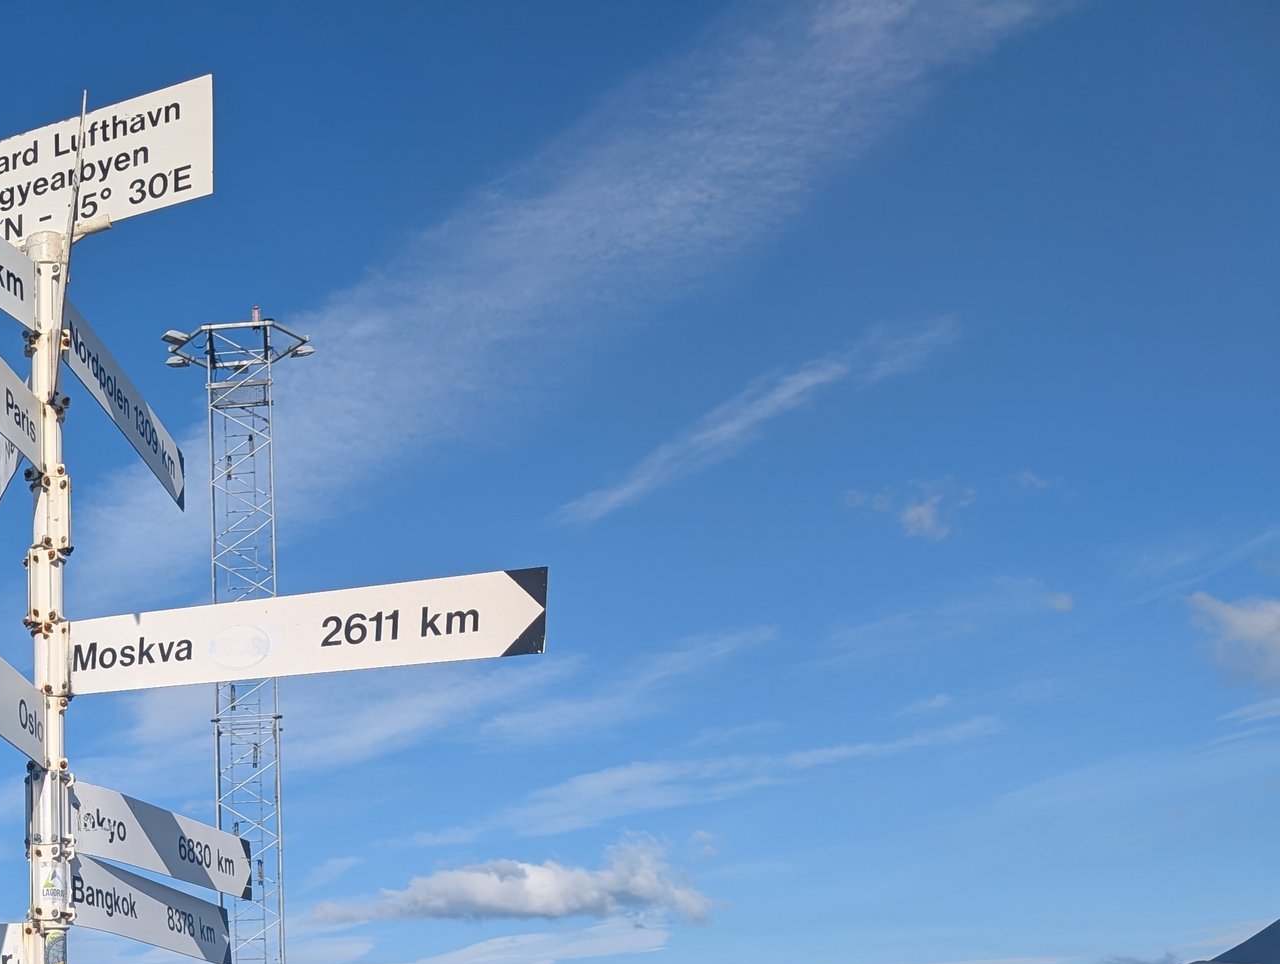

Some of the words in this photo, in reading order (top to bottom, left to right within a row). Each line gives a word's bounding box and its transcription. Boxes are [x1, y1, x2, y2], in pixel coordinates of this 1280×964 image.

[54, 102, 180, 157] Lufthavn
[5, 387, 36, 443] Paris
[69, 319, 130, 420] Nordpolen
[133, 405, 158, 454] 1309
[161, 440, 176, 479] km
[72, 636, 194, 673] Moskva
[321, 609, 400, 648] 2611
[420, 606, 480, 637] km
[19, 698, 44, 743] Oslo
[77, 807, 126, 843] okyo
[178, 835, 212, 868] 6830
[217, 848, 235, 876] km
[72, 875, 138, 919] Bangkok
[167, 906, 195, 937] 8378
[199, 918, 216, 944] km
